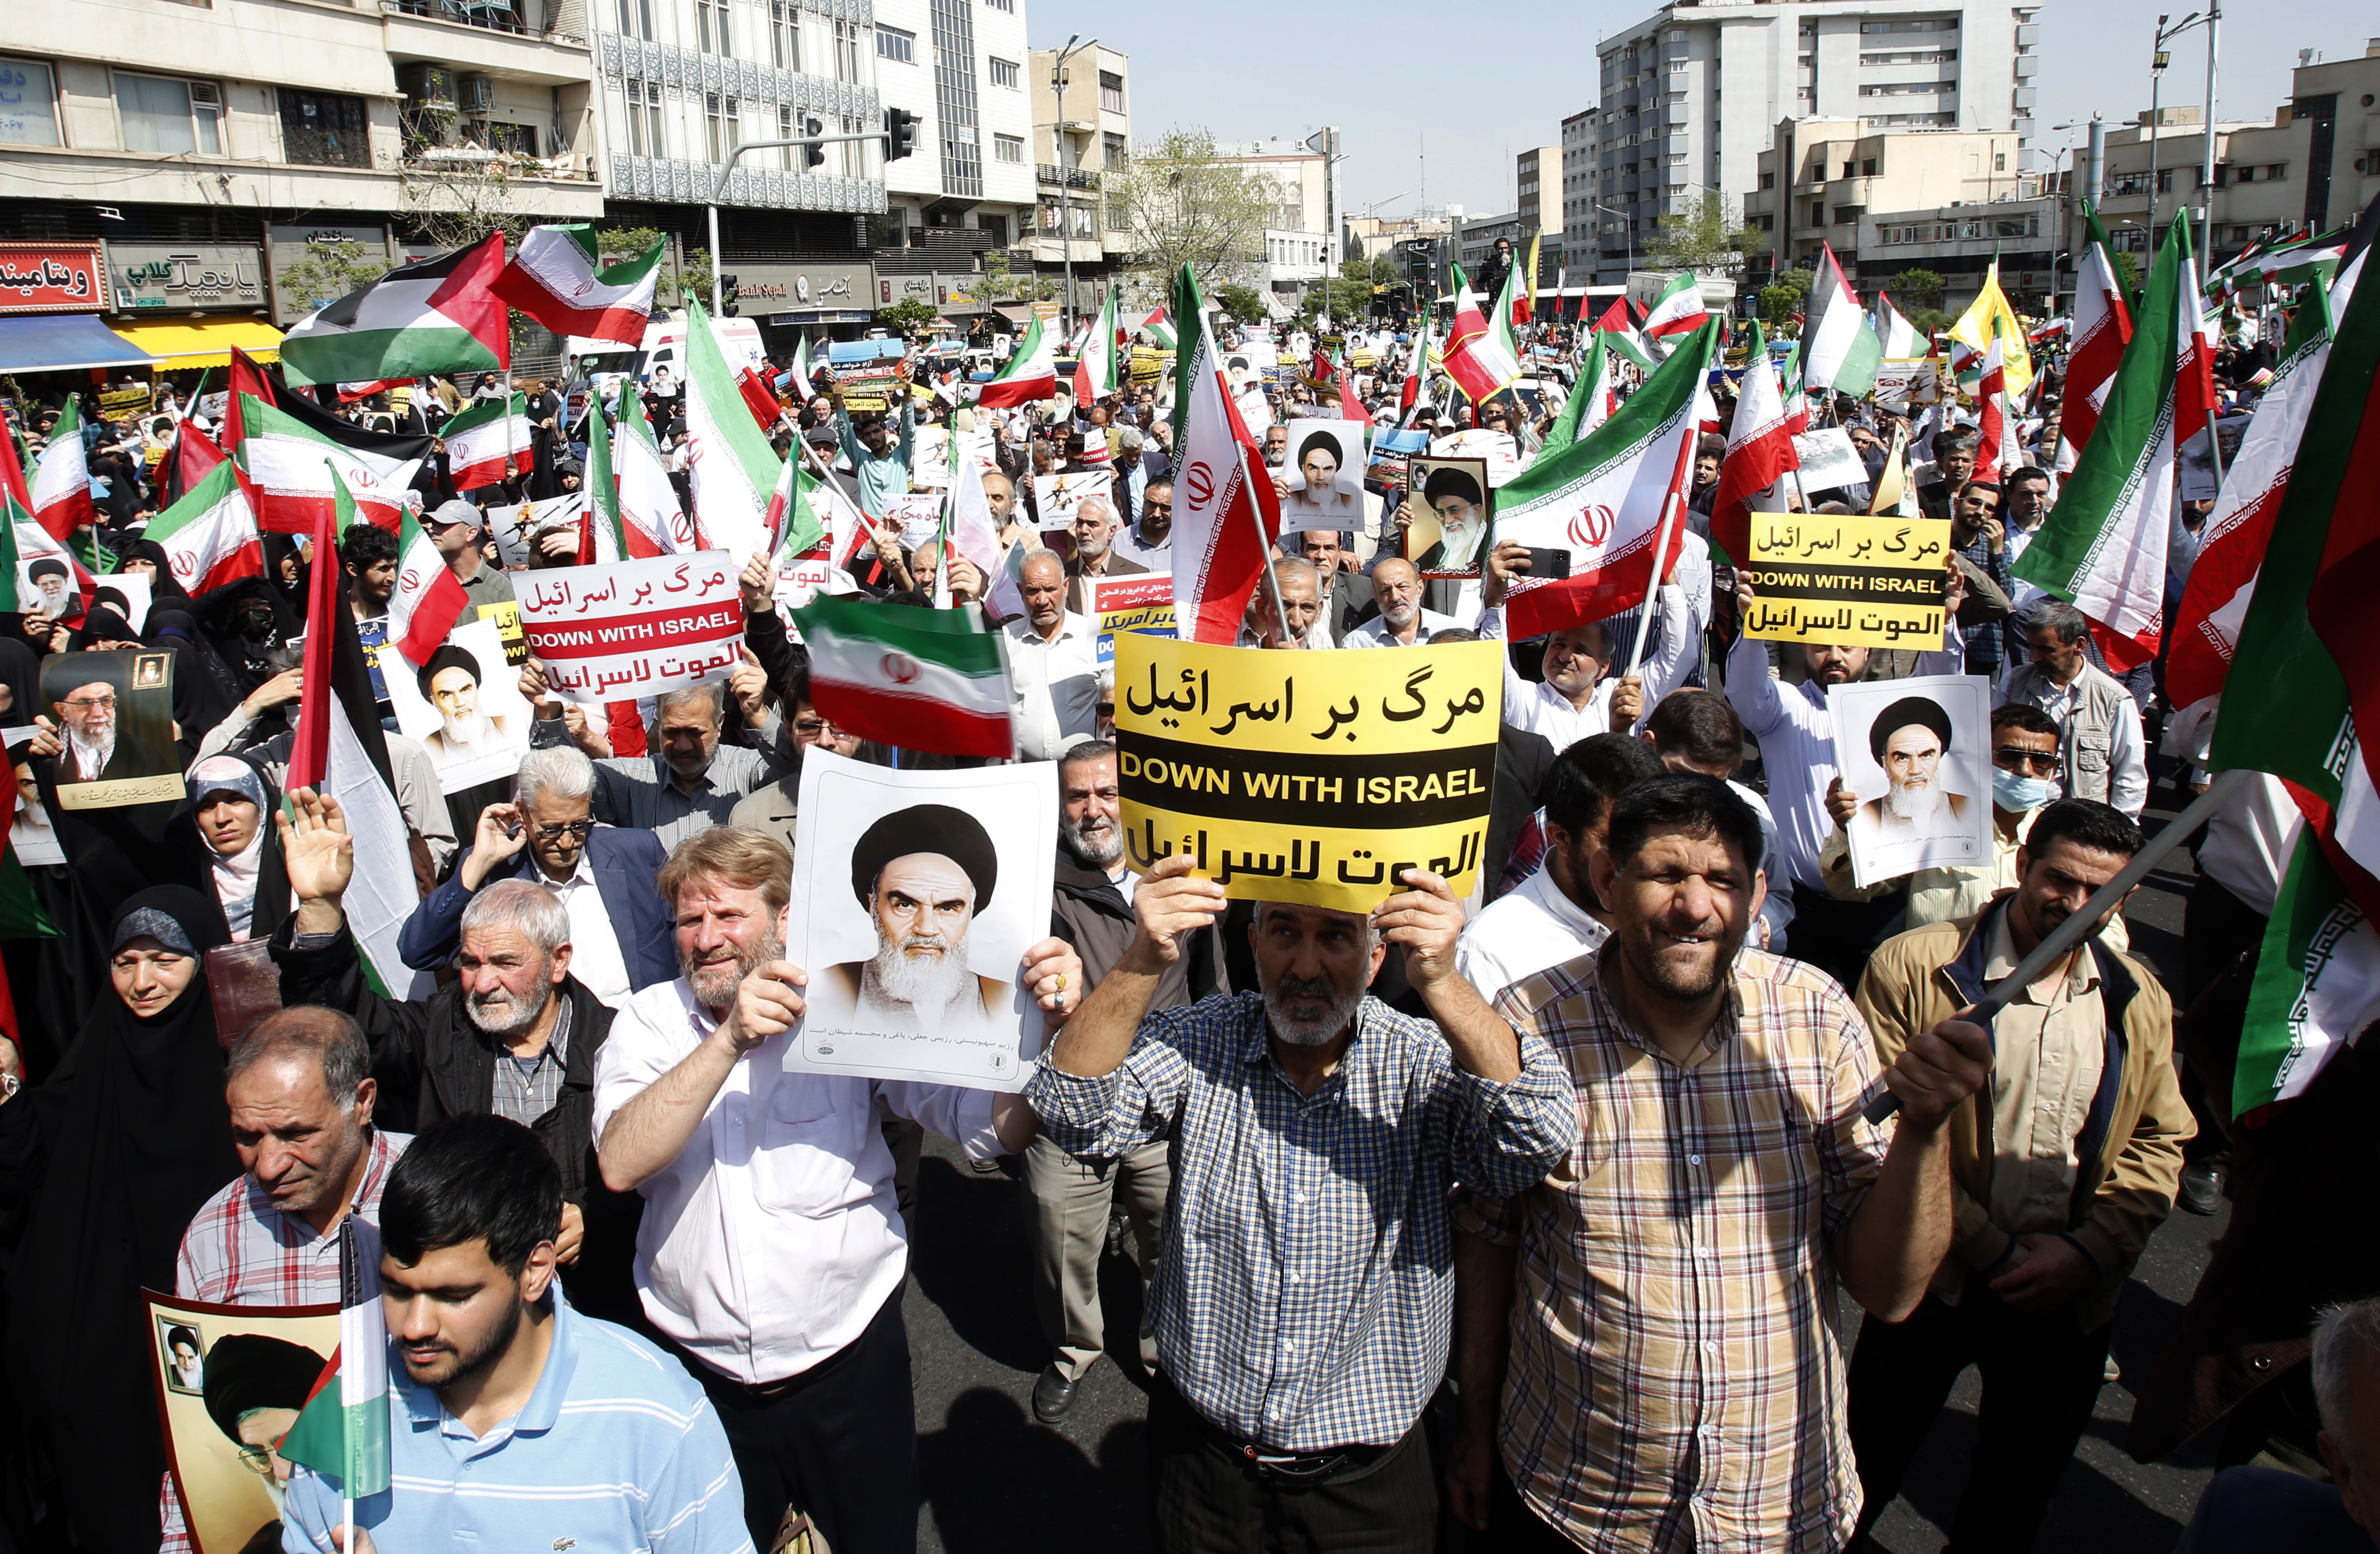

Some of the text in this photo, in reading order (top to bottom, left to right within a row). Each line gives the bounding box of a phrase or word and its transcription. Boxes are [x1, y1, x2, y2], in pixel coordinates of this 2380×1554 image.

[308, 231, 354, 243] ساختمان
[0, 258, 90, 296] ویتامین
[127, 261, 172, 285] کلاب
[737, 284, 787, 298] Bank Sepah
[841, 365, 891, 385] فلسطین
[1243, 402, 1263, 414] سپاه
[1083, 452, 1103, 461] DOWN
[1757, 525, 1940, 561] مرگ بر اسرائیل
[778, 566, 830, 588] الموت
[1750, 571, 1942, 594] DOWN WITH ISRAEL
[525, 562, 725, 615] مرگ بر اسرائیل
[1099, 588, 1119, 598] فلسطین
[1126, 587, 1140, 595] امروز
[1147, 584, 1166, 593] جنایاتی
[529, 611, 737, 647] DOWN WITH ISRAEL
[1103, 607, 1168, 631] بر آمریکا
[1748, 604, 1940, 641] الموت لاسرائیل
[1098, 639, 1114, 654] DO
[543, 641, 744, 695] الموت لاسرائیل
[1126, 662, 1484, 742] مرگ بر اسرائیل
[1121, 751, 1486, 804] DOWN WITH ISRAEL
[828, 1028, 852, 1037] شیطان
[889, 1030, 906, 1040] یاغی
[931, 1034, 952, 1044] رژیمی
[998, 1042, 1014, 1051] رژیم
